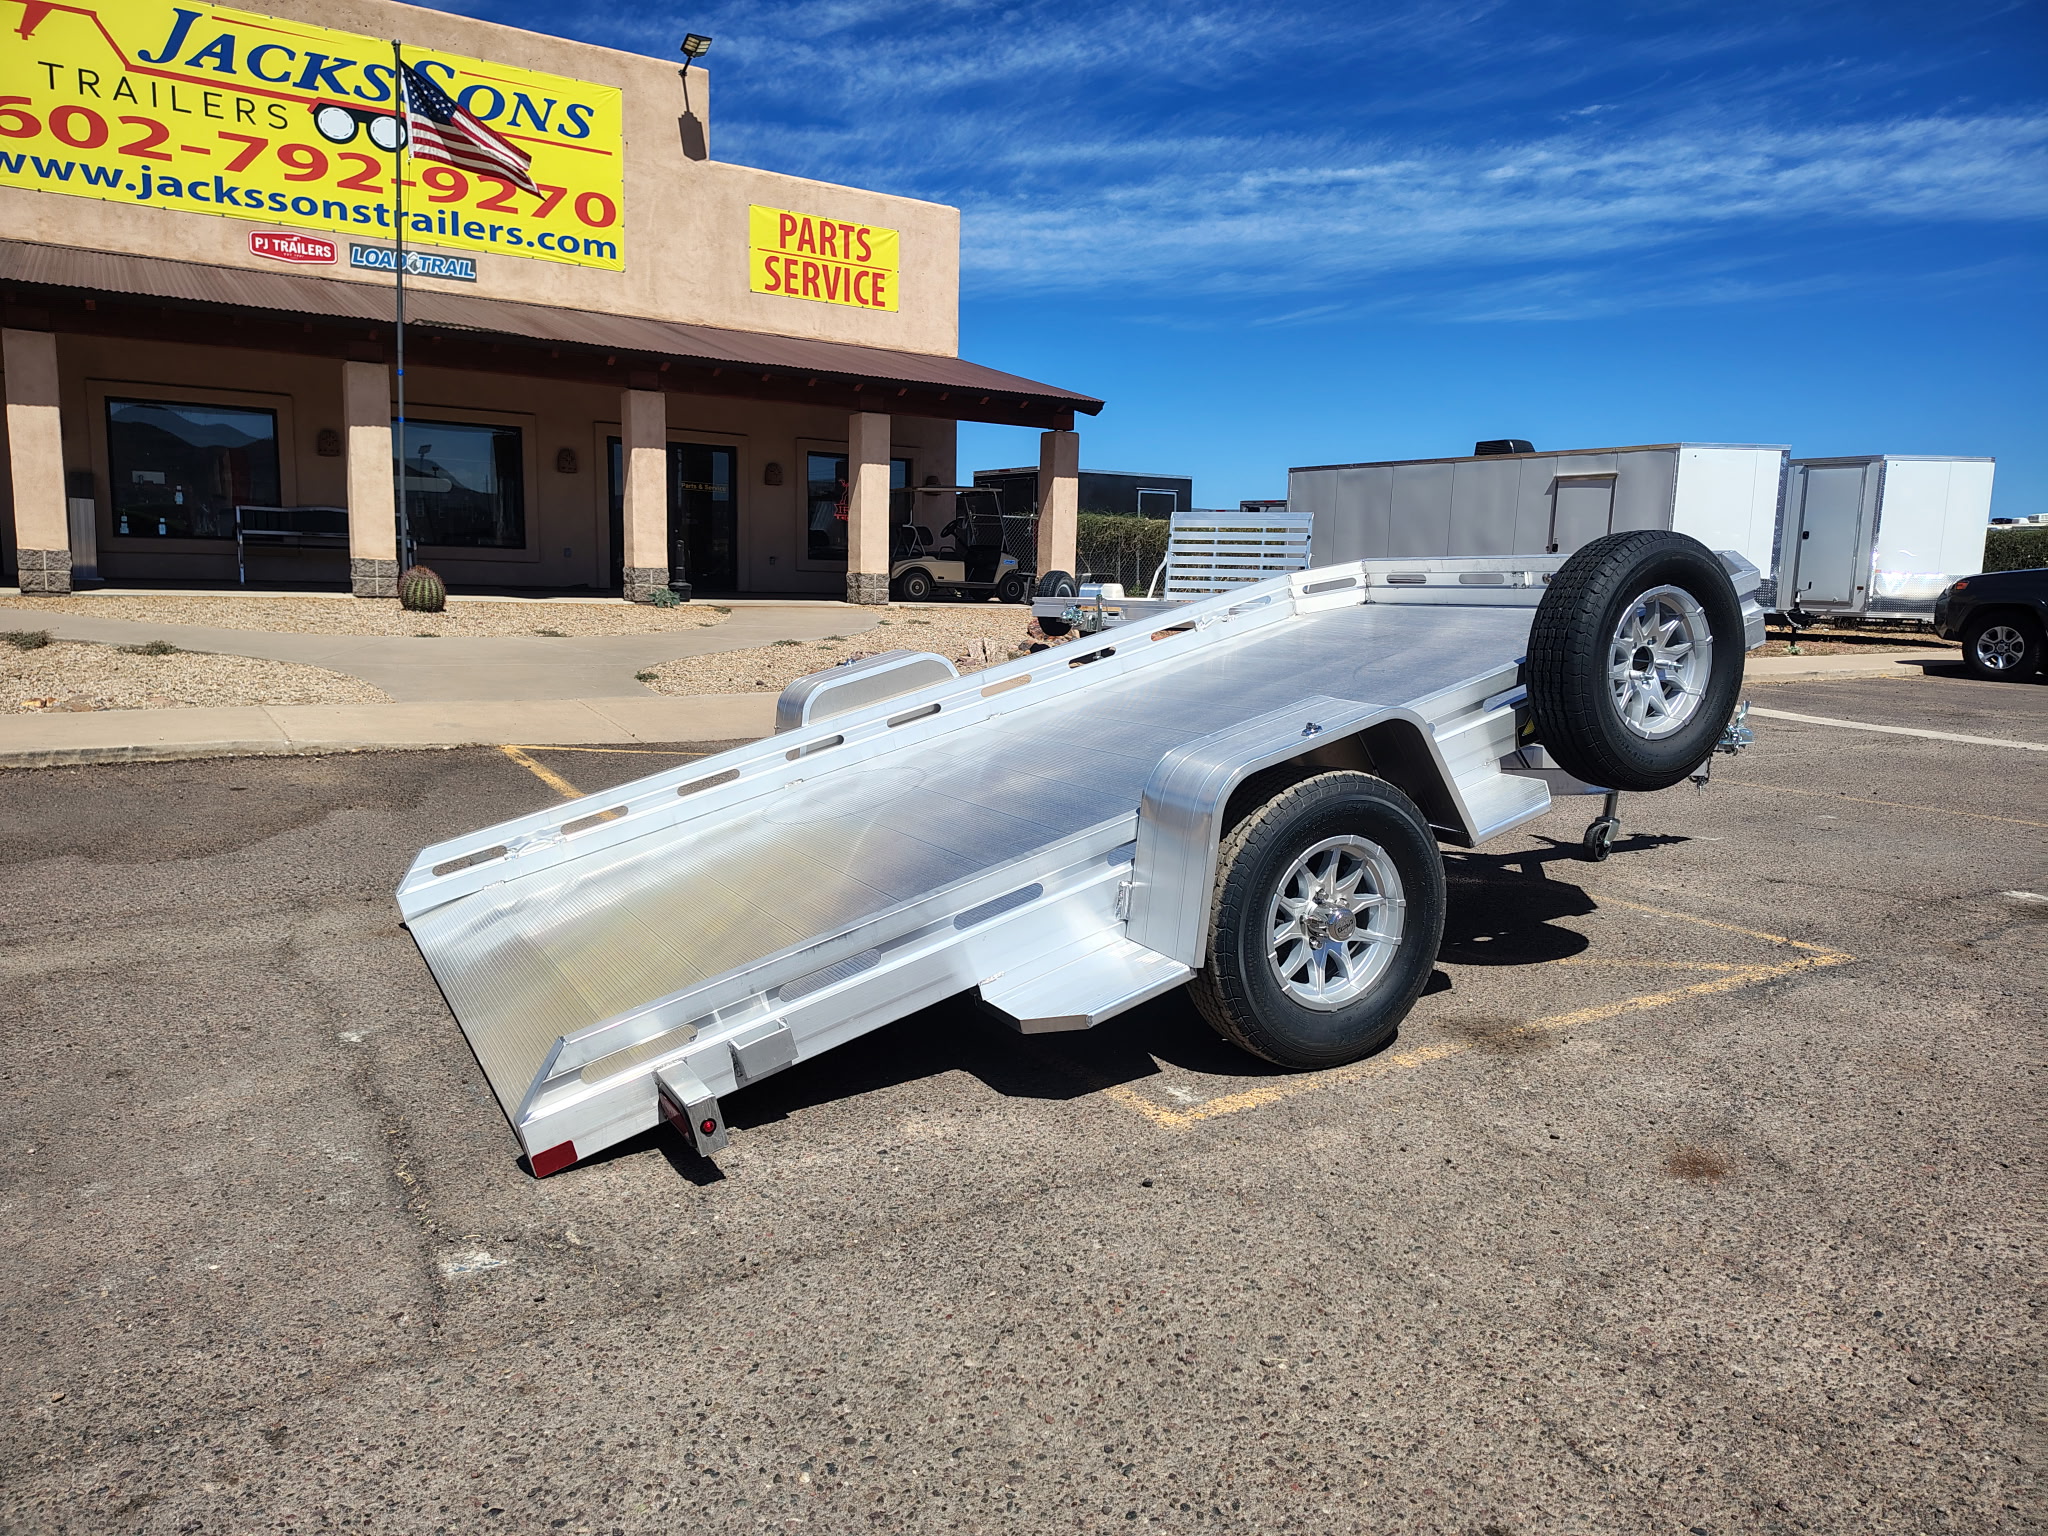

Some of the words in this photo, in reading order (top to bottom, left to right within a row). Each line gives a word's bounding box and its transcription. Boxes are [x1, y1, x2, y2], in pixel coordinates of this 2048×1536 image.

[38, 61, 289, 130] TRAILERS
[0, 96, 617, 228] 602-792-9270
[0, 152, 617, 260] www.jackssonstrailers.com
[255, 237, 269, 250] PJ
[272, 239, 332, 258] TRAILERS
[351, 246, 408, 269] LOAD
[418, 254, 476, 279] TRAIL
[779, 213, 872, 262] PARTS
[764, 256, 886, 308] SERVICE
